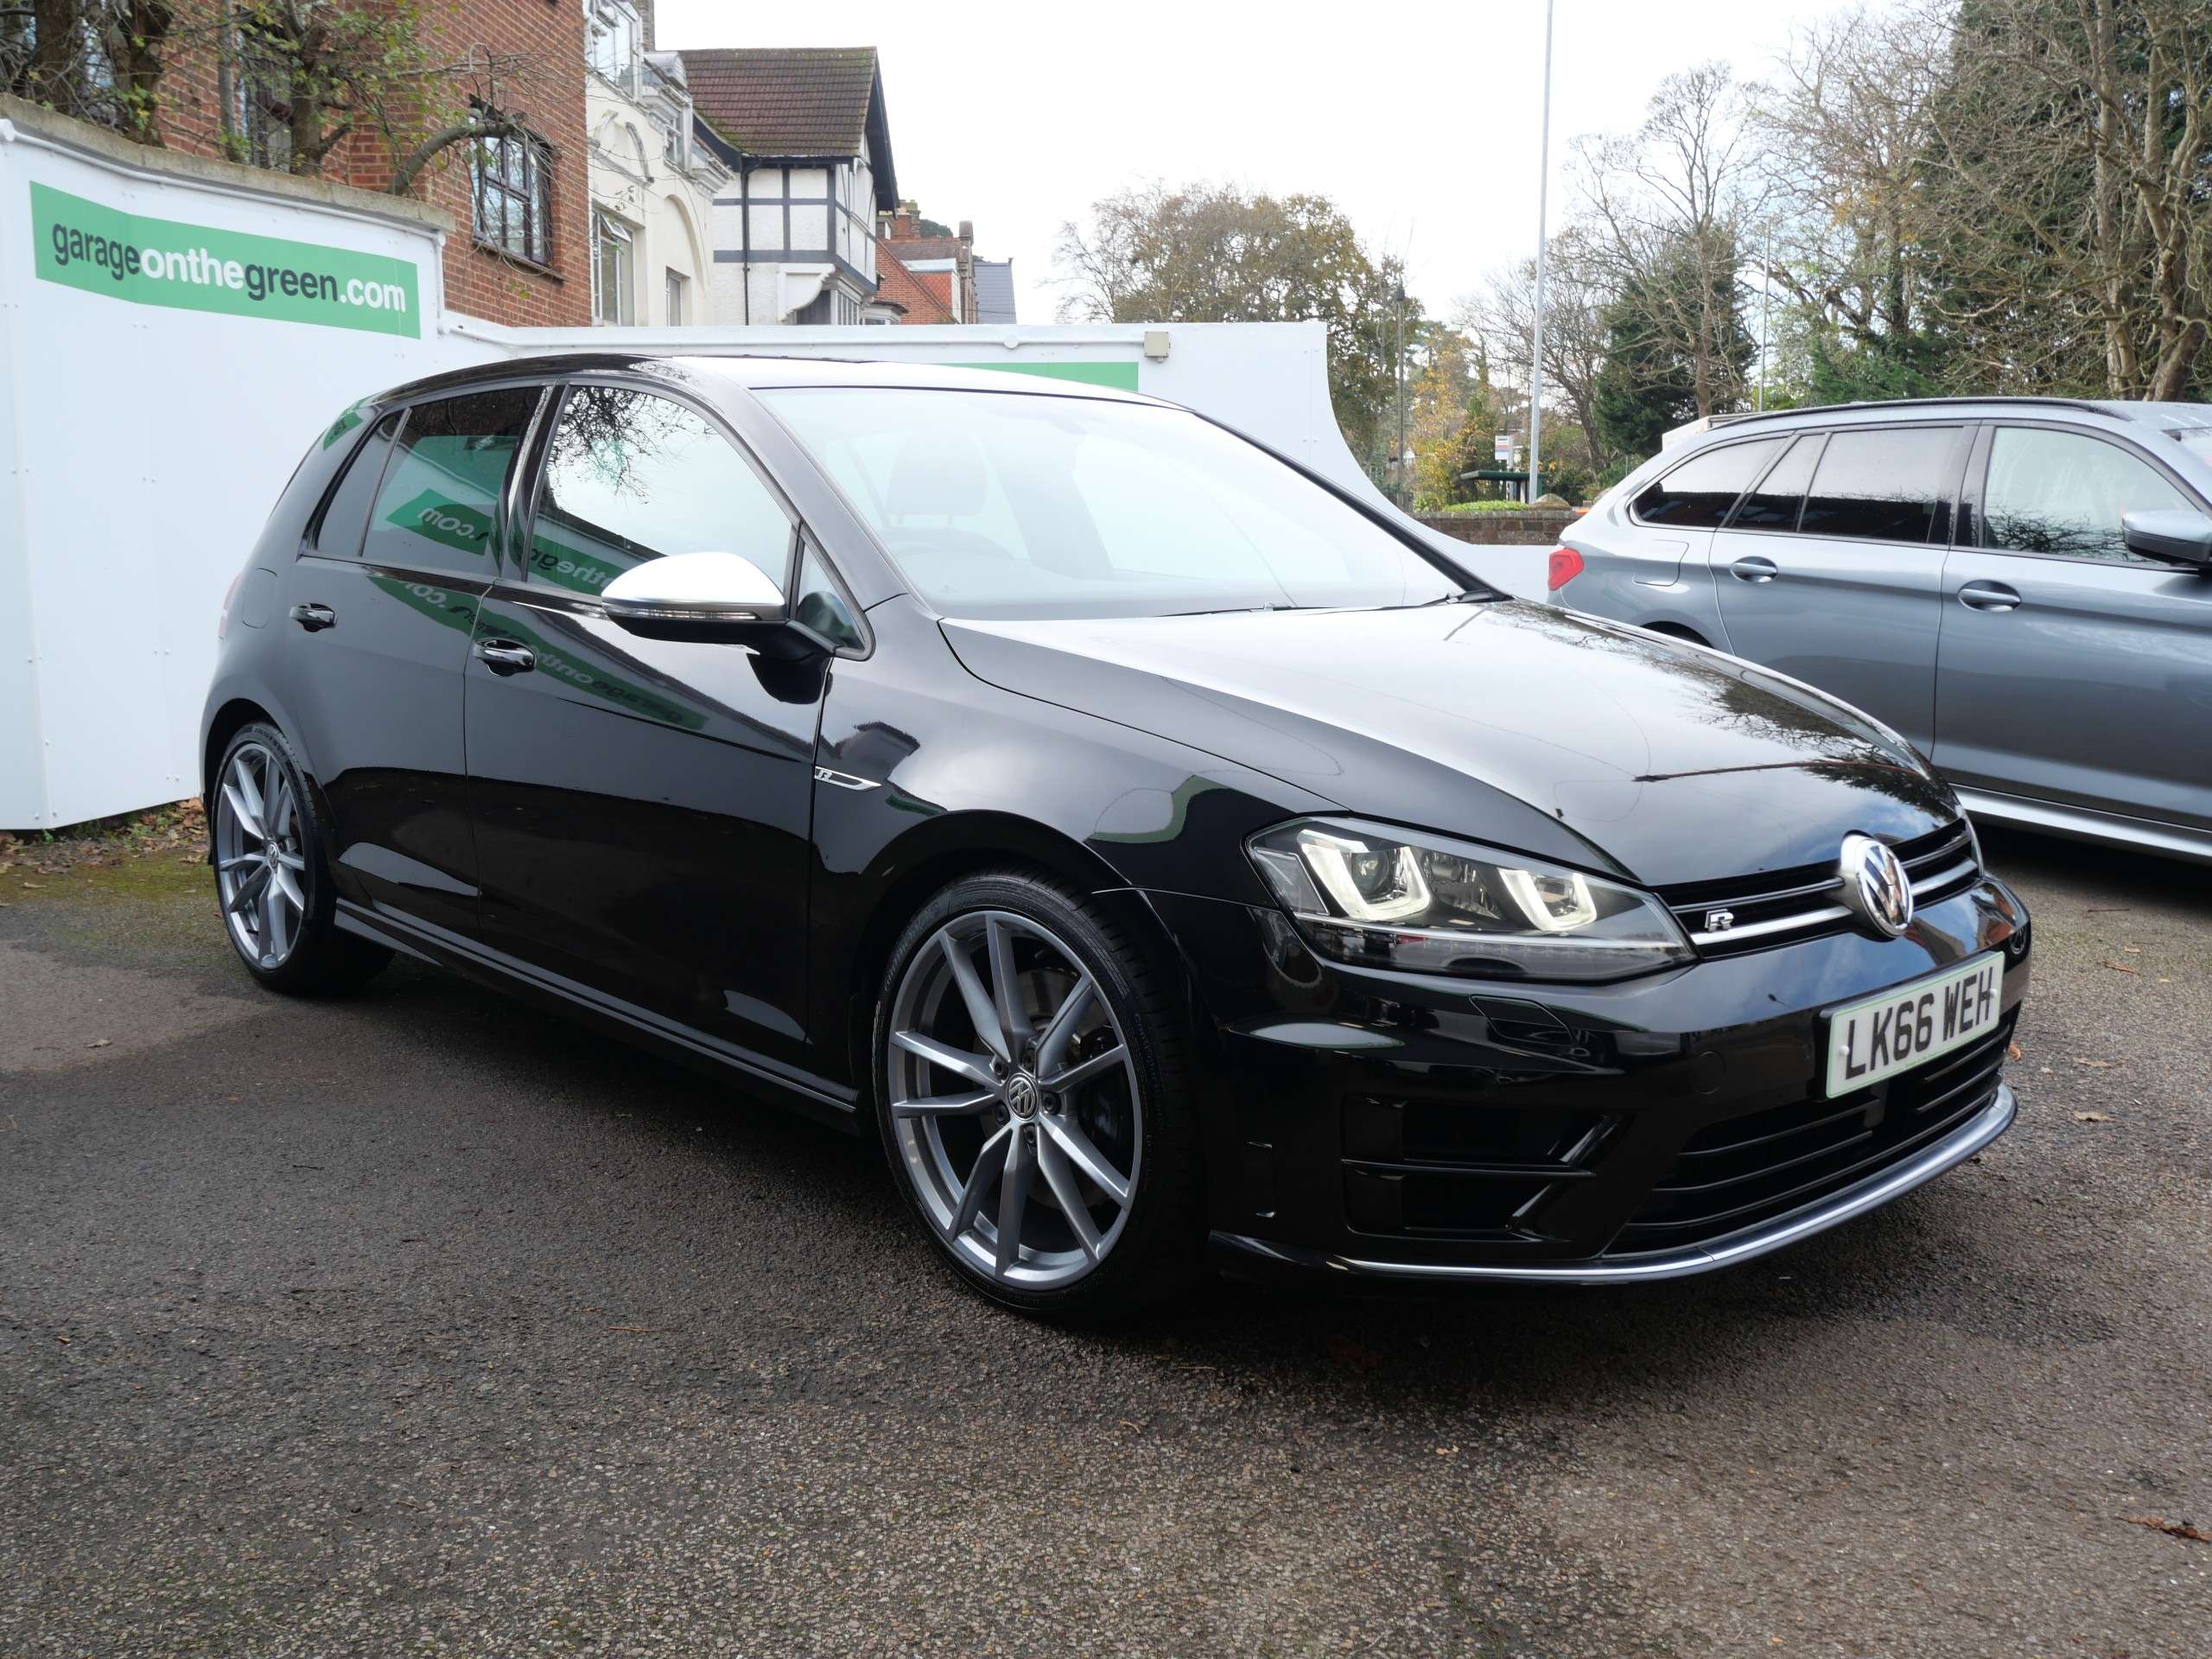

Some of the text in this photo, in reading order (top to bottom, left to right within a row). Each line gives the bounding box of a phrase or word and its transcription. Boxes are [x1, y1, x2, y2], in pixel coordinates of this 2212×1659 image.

[52, 221, 407, 314] garageonthegreen.com
[1705, 908, 1734, 932] R
[1845, 966, 1993, 1080] LK66 WEH
